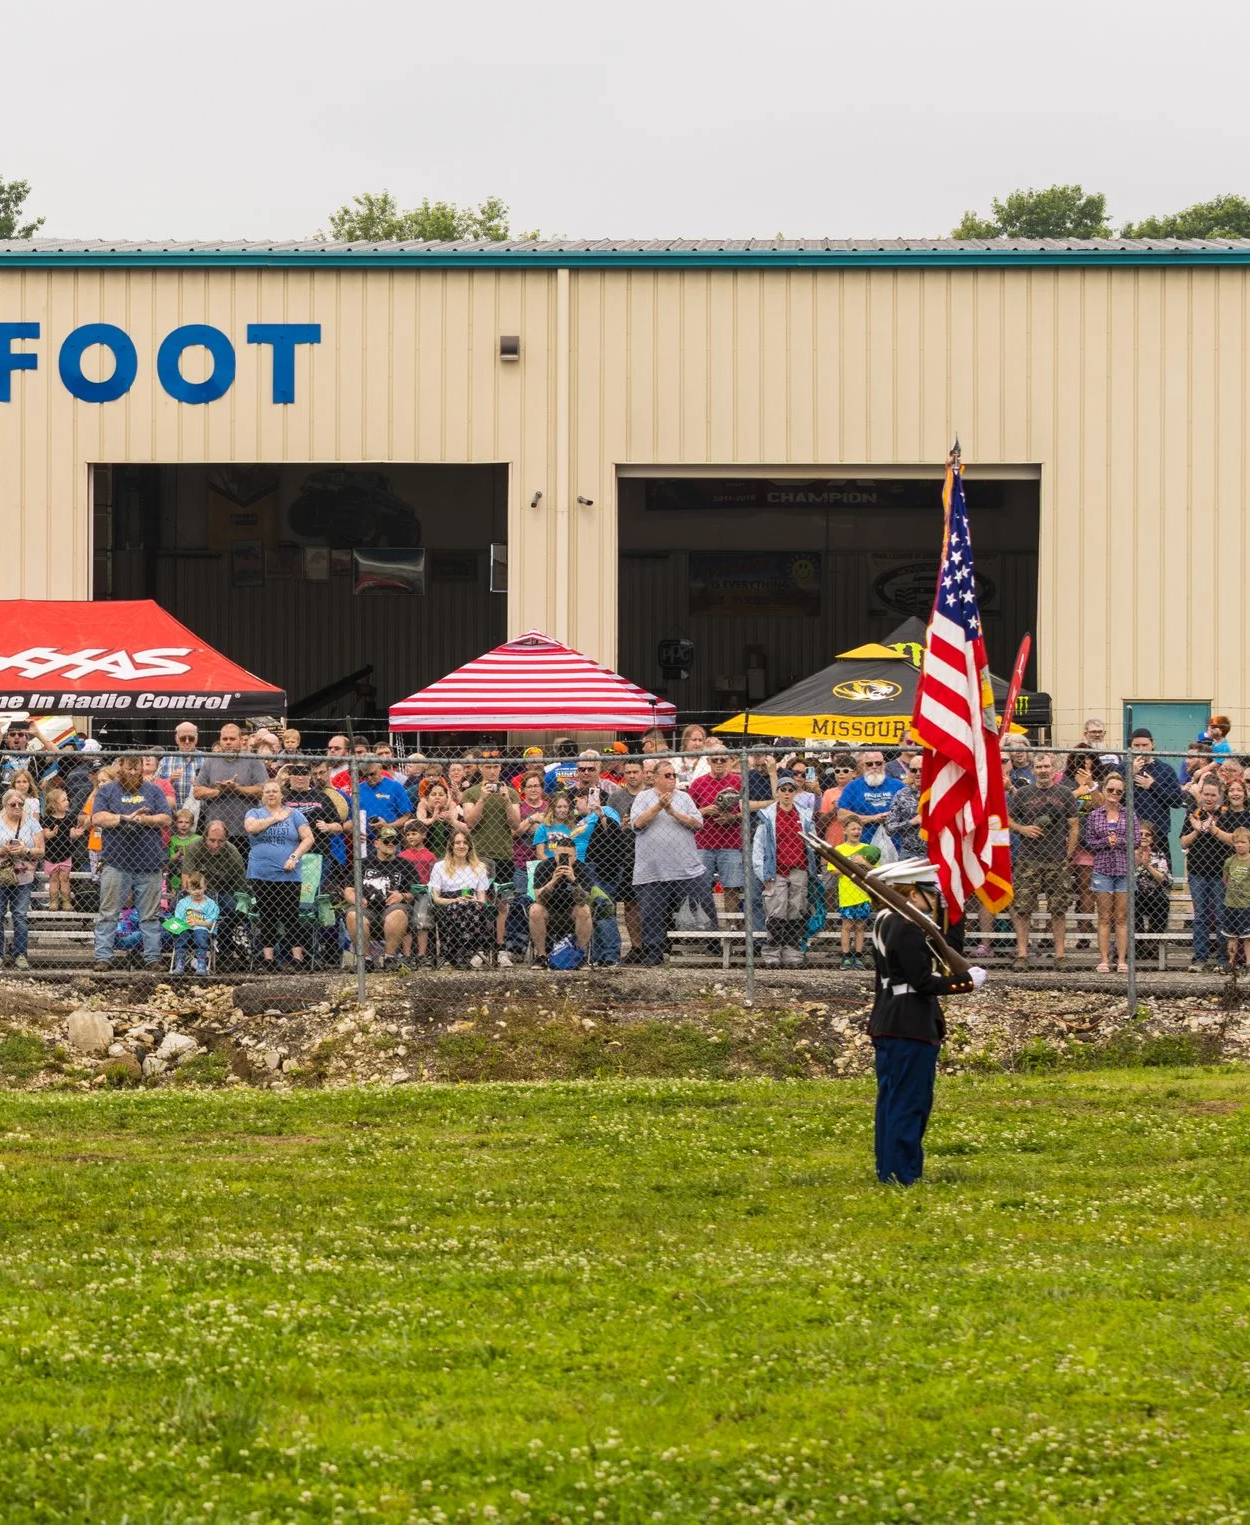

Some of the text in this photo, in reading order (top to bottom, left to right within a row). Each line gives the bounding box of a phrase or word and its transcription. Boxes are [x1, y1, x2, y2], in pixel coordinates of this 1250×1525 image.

[766, 492, 877, 504] CHAMPION
[723, 579, 789, 589] EVERYTHING
[28, 693, 54, 709] In
[58, 693, 132, 709] Radio
[811, 718, 912, 738] MISSOUR
